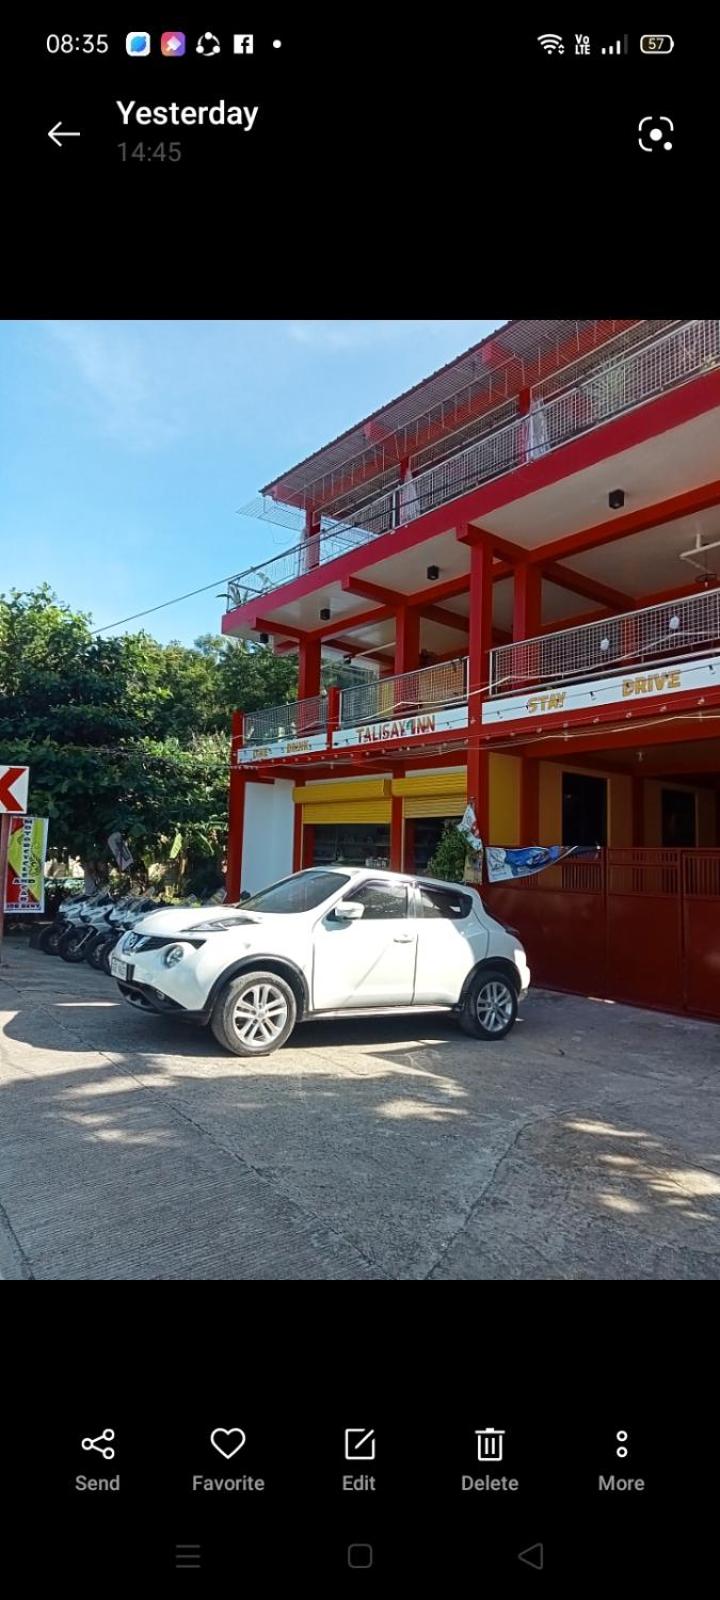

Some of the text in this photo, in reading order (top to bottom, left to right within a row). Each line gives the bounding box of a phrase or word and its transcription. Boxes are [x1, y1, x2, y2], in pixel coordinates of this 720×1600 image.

[46, 34, 108, 53] 08:35
[575, 34, 590, 44] Vo
[648, 37, 664, 50] 57
[575, 44, 591, 55] LTE
[116, 100, 258, 131] Yesterday
[117, 142, 182, 162] 14:45
[528, 669, 681, 713] STAY DRIVE
[355, 714, 436, 743] TALISAY INN
[75, 1475, 119, 1491] Send
[193, 1475, 265, 1491] Favorite
[342, 1475, 376, 1491] Edit
[461, 1475, 519, 1491] Delete
[599, 1475, 645, 1491] More
